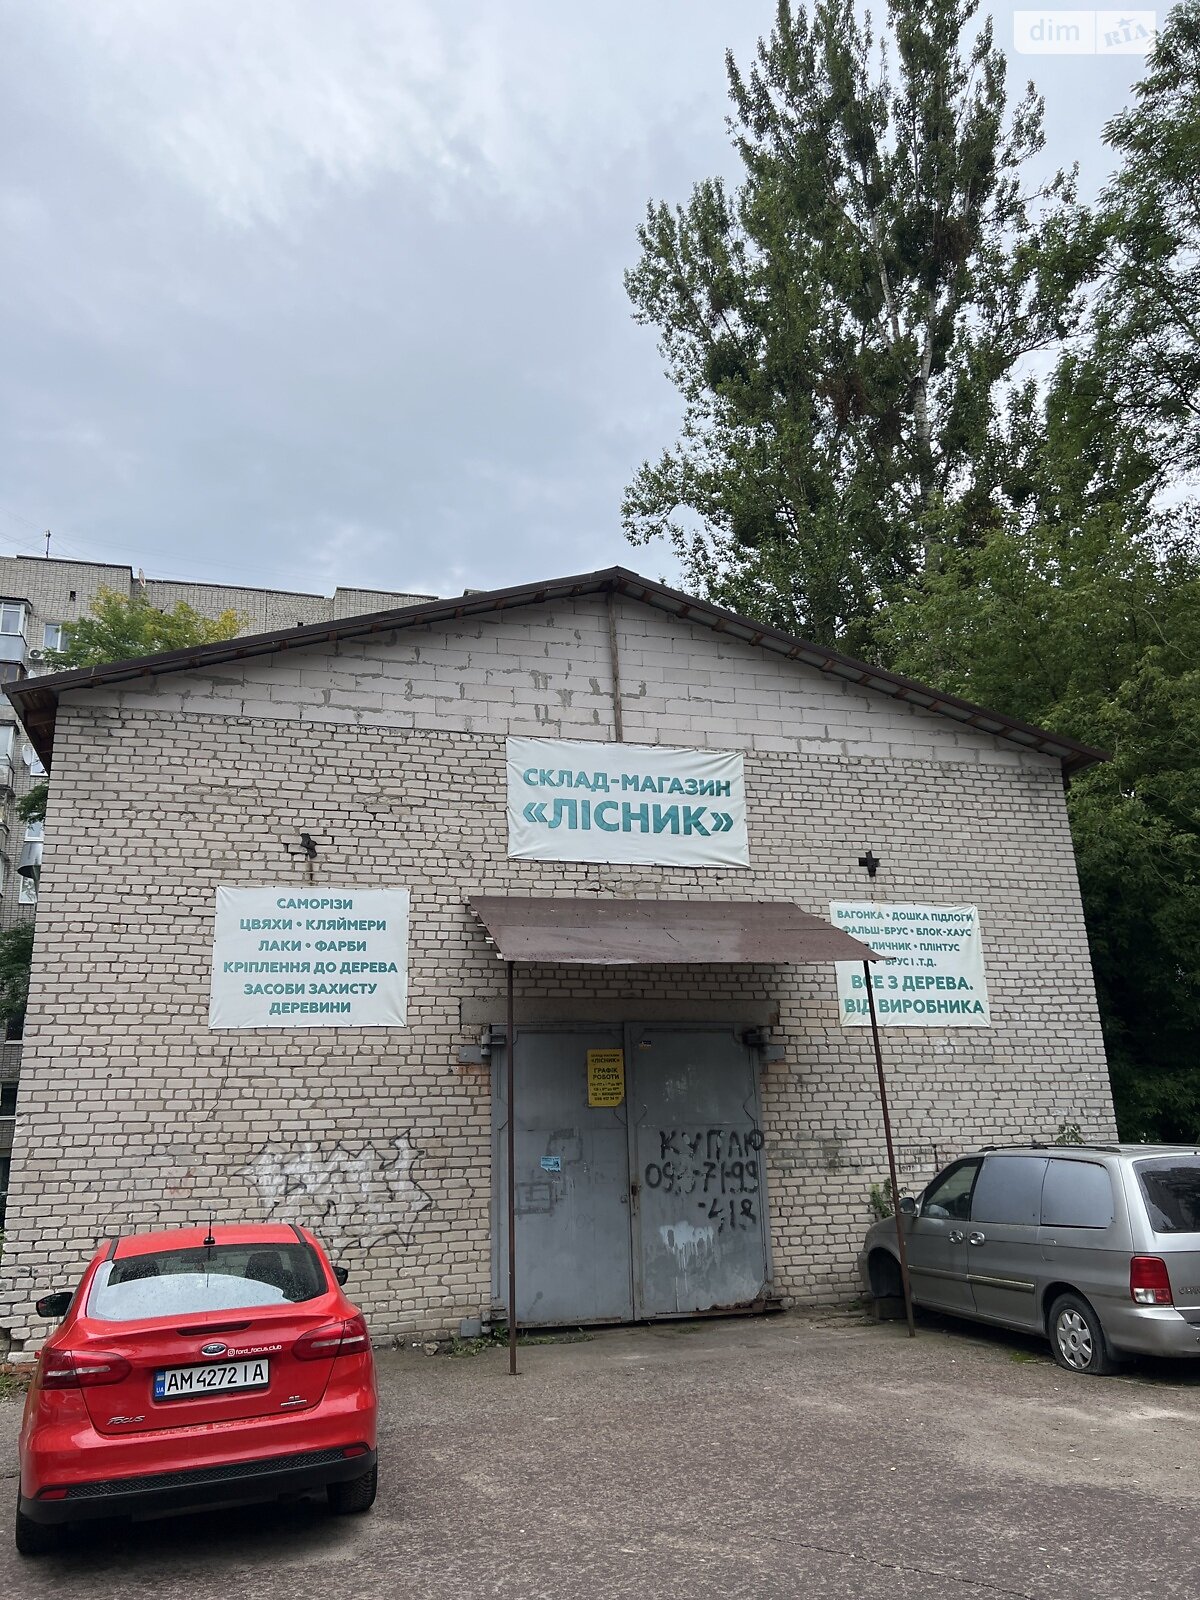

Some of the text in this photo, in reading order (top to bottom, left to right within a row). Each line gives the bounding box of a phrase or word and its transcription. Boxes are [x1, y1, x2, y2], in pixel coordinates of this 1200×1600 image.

[522, 767, 732, 797] СКЛАД-МАГАЗИН
[522, 797, 735, 837] «ЛІСНИК»
[276, 897, 353, 910] САМОРІЗИ
[837, 910, 974, 923] ВАГОНКА ДОШКА ПІДЛОГИ
[239, 917, 387, 932] ЦВЯХИ КЛЯЙМЕРИ
[916, 928, 972, 937] БЛОК-ХАУС
[257, 940, 367, 952] ЛАКИ ФАРБИ
[867, 941, 960, 952] ЛИЧНИК ПЛІНТУС
[223, 961, 398, 975] КРІПЛЕННЯ ДО ДЕРЕВА
[243, 982, 378, 996] ЗАСОБИ ЗАХИСТУ
[888, 975, 899, 990] З
[902, 975, 973, 992] ДЕРЕВА.
[269, 1001, 352, 1015] ДЕРЕВИНИ
[878, 998, 985, 1014] ВИРОБНИКА
[167, 1371, 193, 1392] AM
[196, 1367, 237, 1387] 4272
